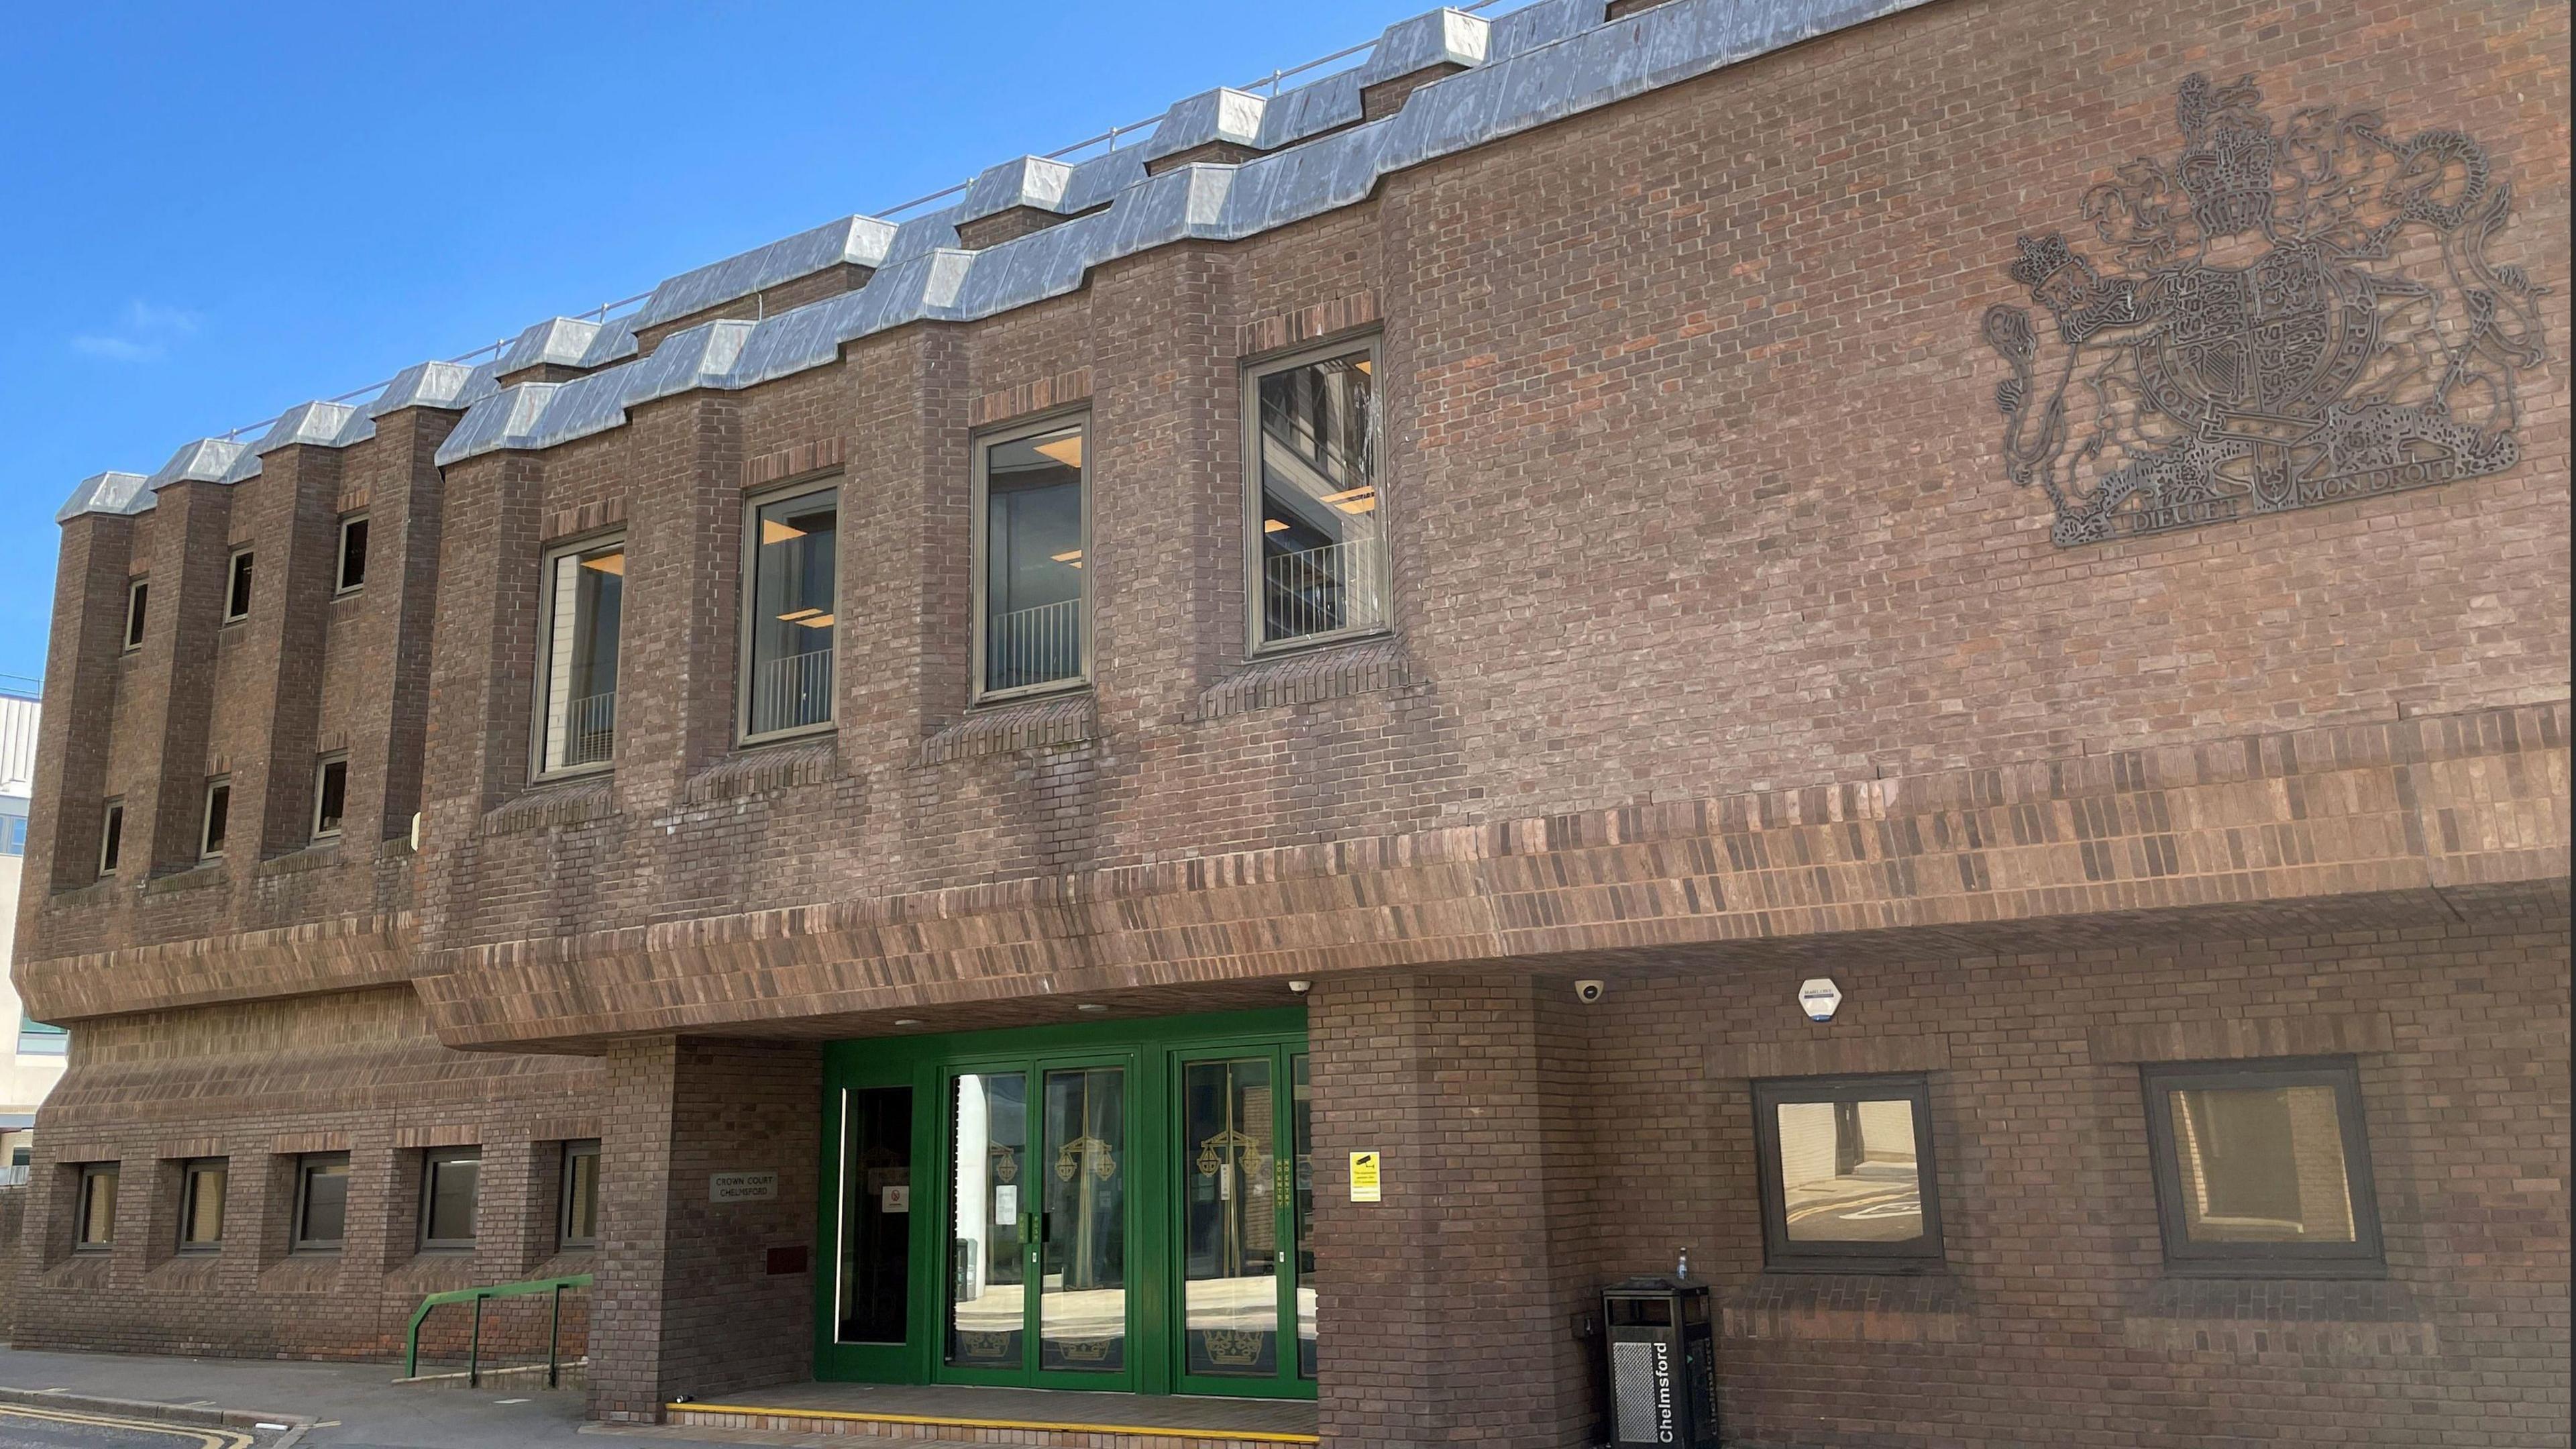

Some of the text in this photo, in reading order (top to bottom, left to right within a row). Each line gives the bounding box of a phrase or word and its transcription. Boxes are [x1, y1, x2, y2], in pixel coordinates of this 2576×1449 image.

[2299, 459, 2455, 500] MON DROIT
[2133, 497, 2239, 531] DIEU ET
[716, 1176, 773, 1186] CROWN COURT
[720, 1187, 767, 1197] CHELMSFORD
[1654, 1342, 1673, 1443] Chelmsford
